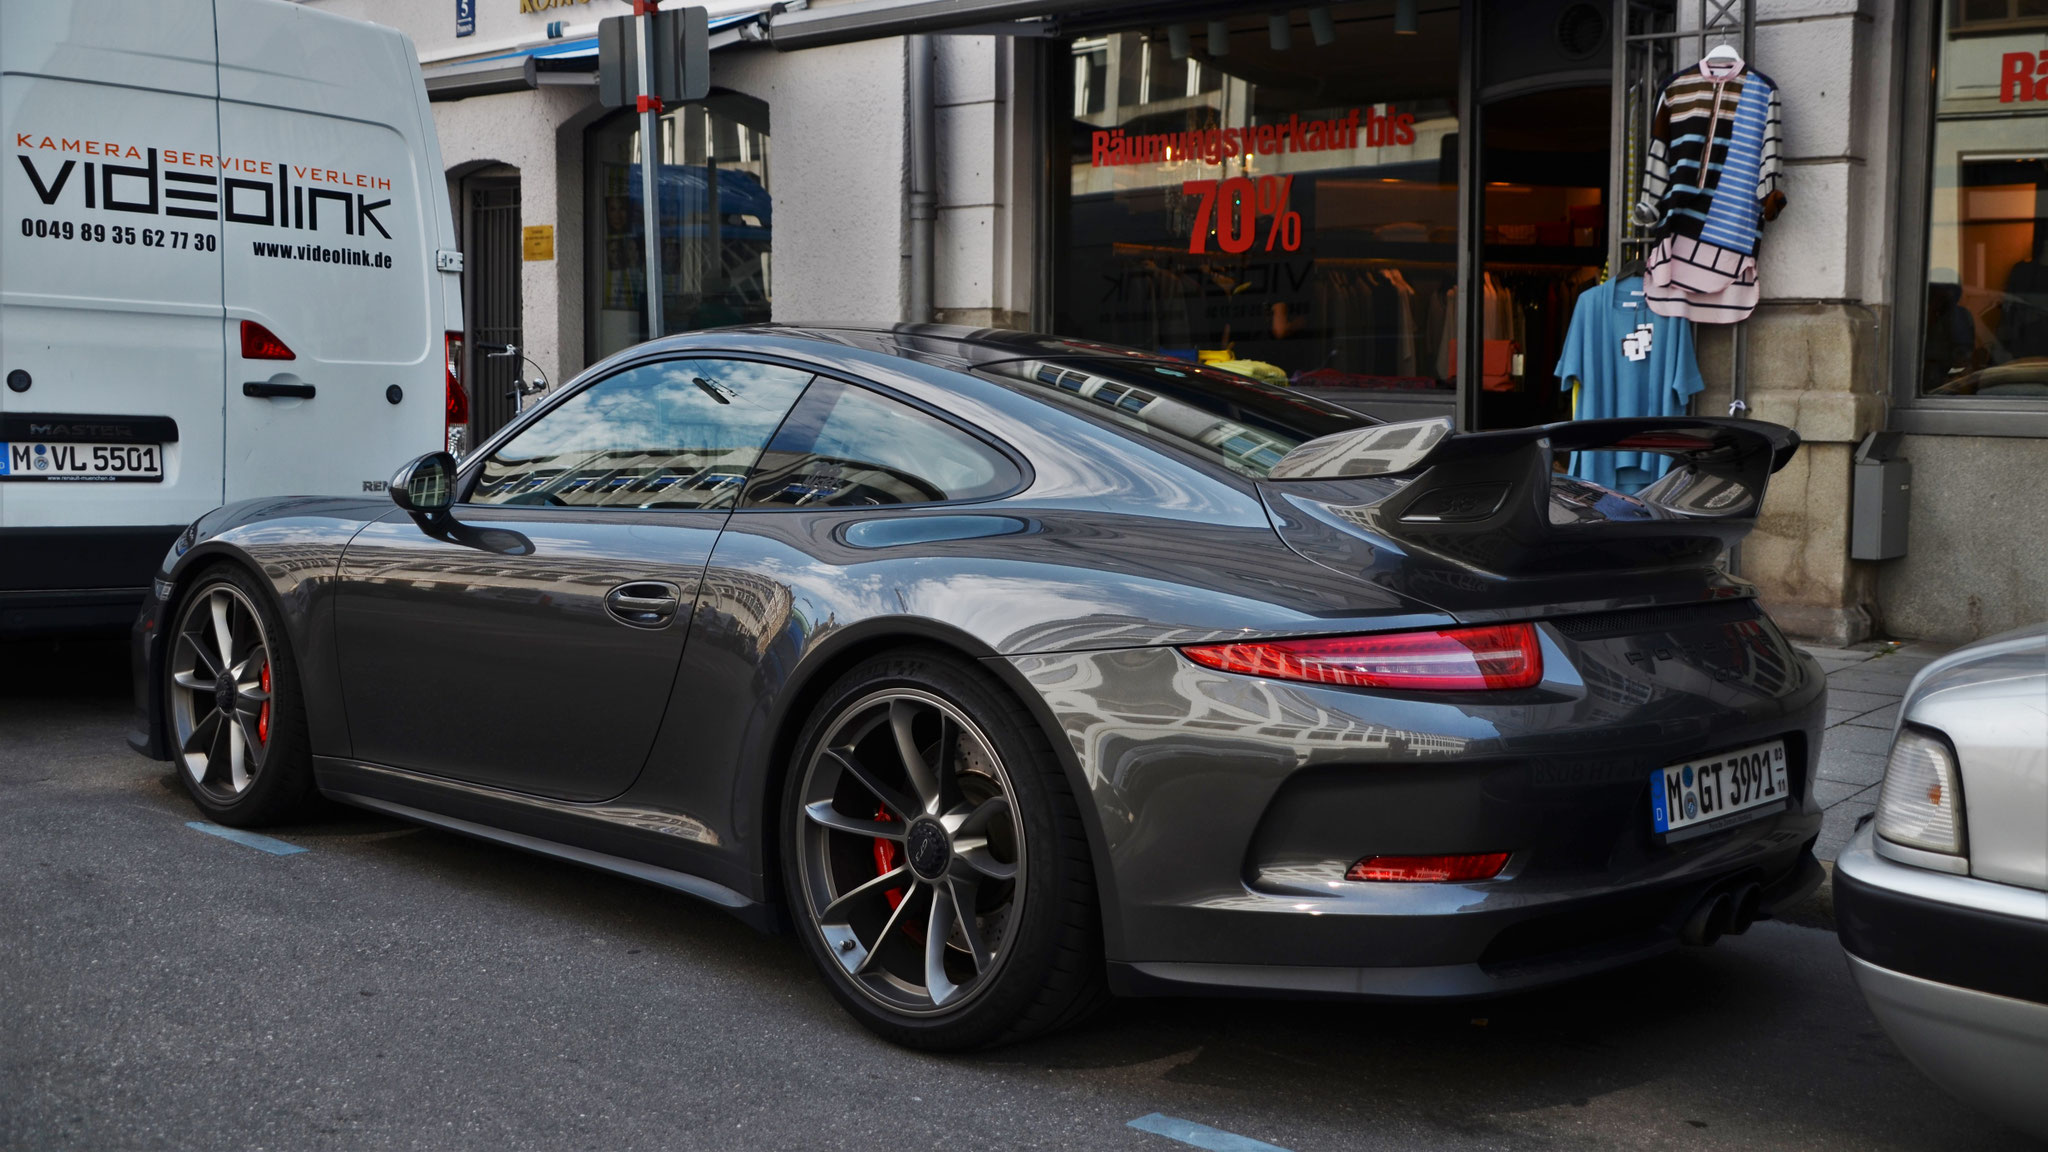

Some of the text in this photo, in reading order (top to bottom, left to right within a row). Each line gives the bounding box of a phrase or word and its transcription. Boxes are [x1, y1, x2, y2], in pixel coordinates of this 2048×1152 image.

[461, 0, 469, 17] 5
[1091, 105, 1416, 168] Räumungsverkauf bis
[17, 133, 391, 191] KAMERA SERVICE VERLEIH
[1182, 174, 1302, 255] 70%
[21, 217, 217, 253] 0049 89 35 62 77 30
[252, 241, 393, 270] www.videolink.de
[30, 423, 133, 436] MASTER
[12, 445, 159, 472] M VL 5501
[1666, 750, 1776, 823] M GT 3991
[1656, 807, 1664, 822] D
